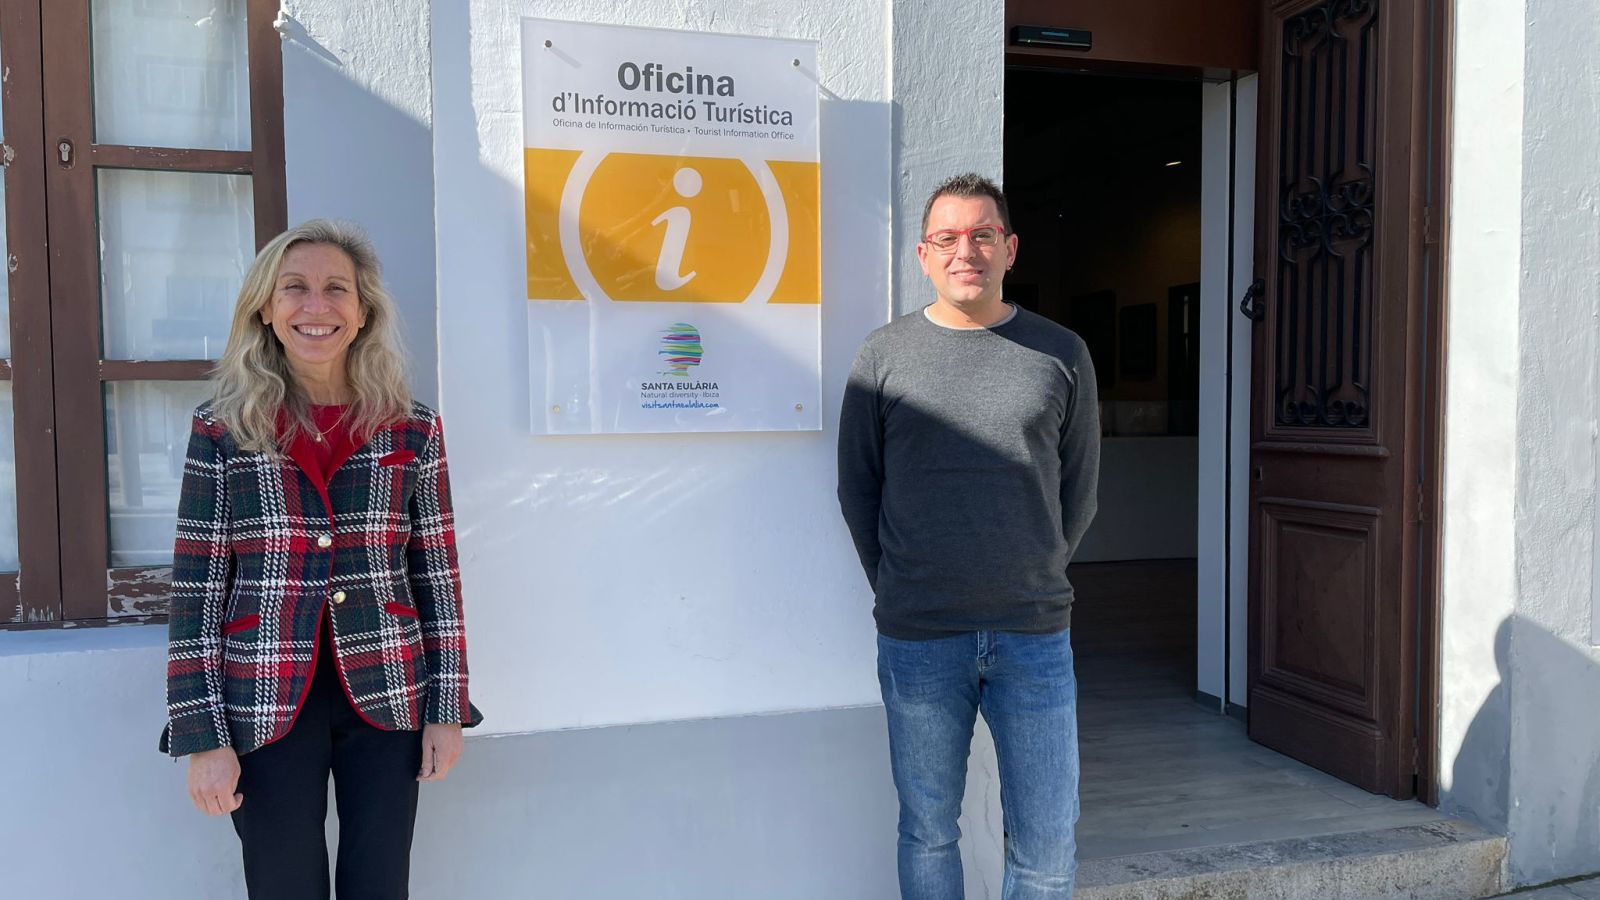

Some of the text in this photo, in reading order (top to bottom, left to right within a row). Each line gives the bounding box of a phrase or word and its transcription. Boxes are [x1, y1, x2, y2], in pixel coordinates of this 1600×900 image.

[617, 61, 735, 97] Oficina
[703, 101, 793, 126] Turística
[552, 118, 795, 140] Oficina de Información Turística Tourist Information Office
[641, 382, 674, 390] SANTA
[669, 391, 698, 399] diversity
